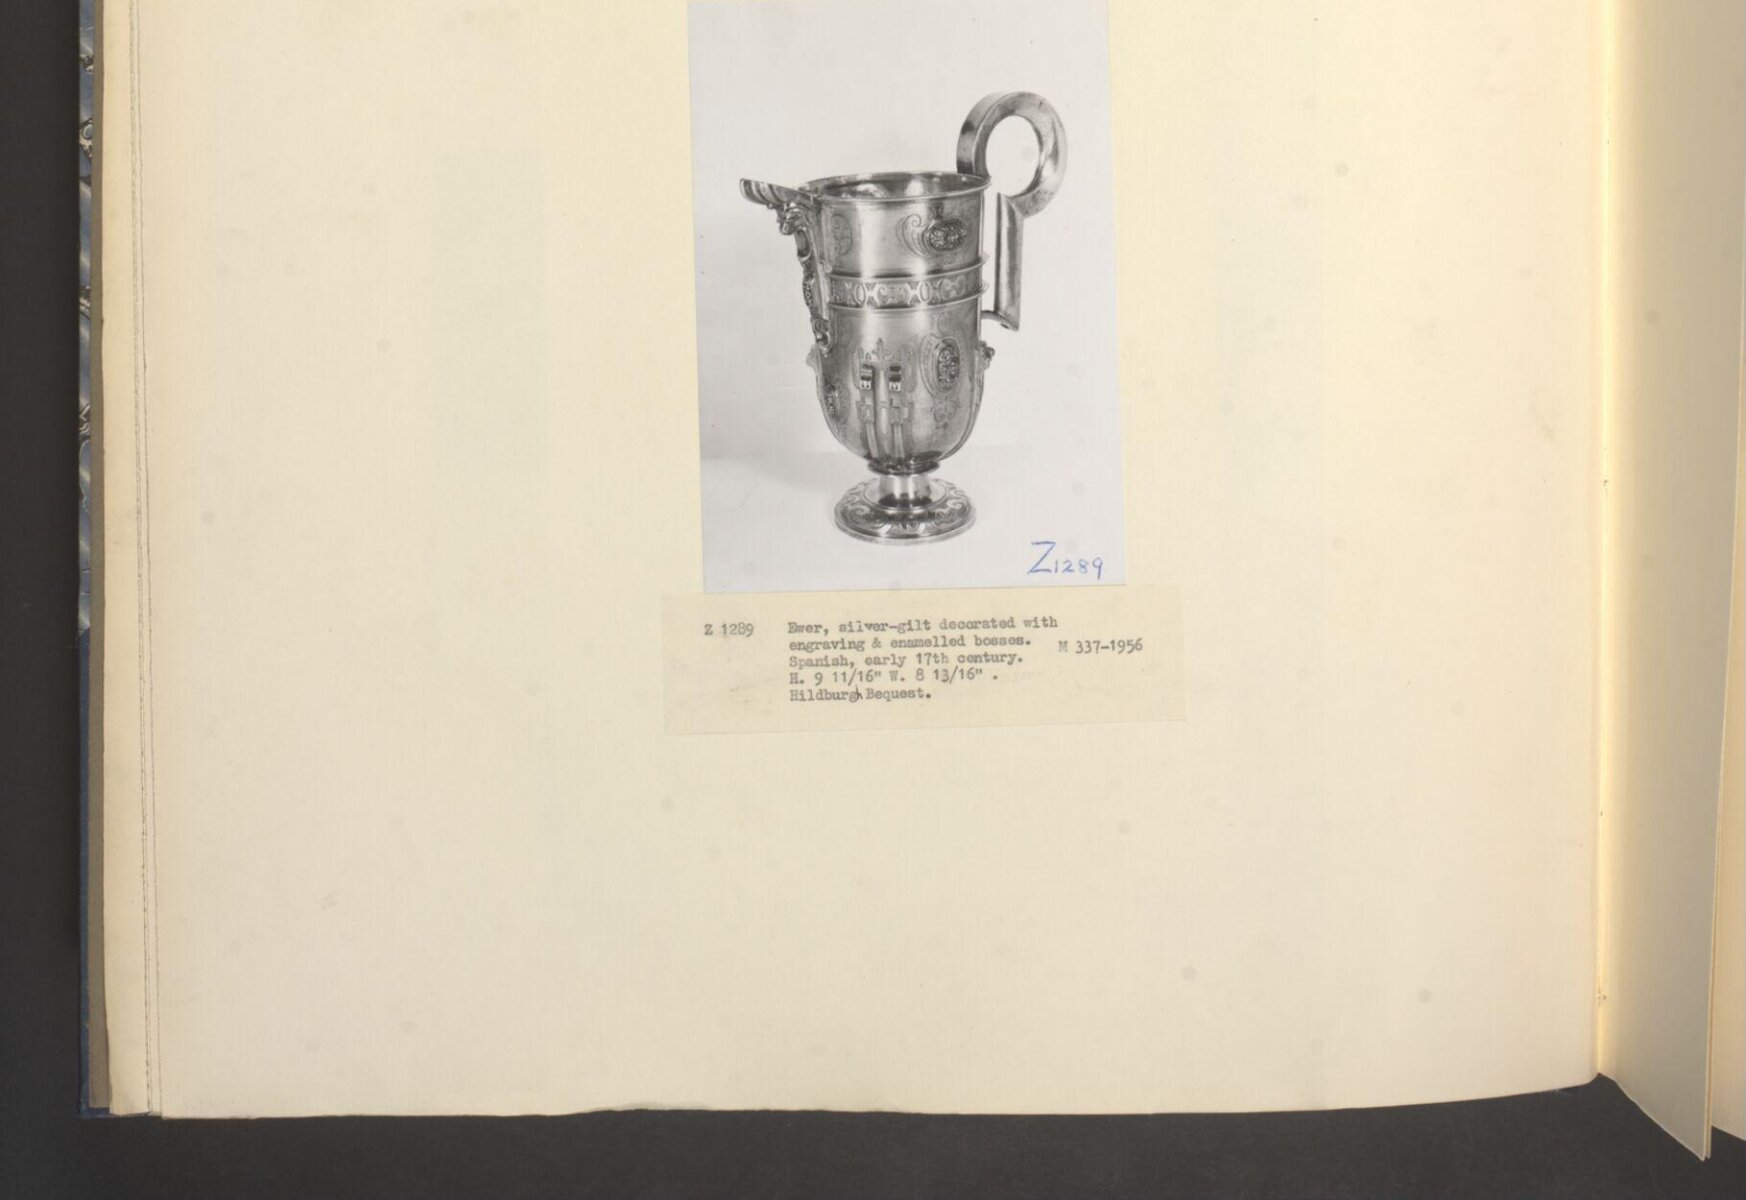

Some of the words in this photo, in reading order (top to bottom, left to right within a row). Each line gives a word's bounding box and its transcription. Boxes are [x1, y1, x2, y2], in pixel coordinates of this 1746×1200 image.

[1026, 541, 1104, 580] Z1289
[704, 624, 714, 636] Z
[721, 622, 755, 637] 1289
[787, 621, 830, 636] Ewer,
[838, 619, 931, 634] silver-gilt
[939, 617, 1016, 630] decorated
[1023, 616, 1059, 628] with
[789, 637, 866, 652] engraving
[872, 637, 882, 649] &
[890, 635, 966, 648] enamelled
[974, 634, 1032, 647] bosses.
[1058, 641, 1069, 653] M
[1075, 638, 1144, 654] 337-1956
[789, 655, 855, 670] Spanish,
[865, 653, 907, 668] early
[916, 652, 950, 666] 17th
[957, 651, 1024, 666] century.
[789, 672, 805, 685] H.
[814, 672, 824, 687] 9
[832, 668, 882, 687] 11/16"
[890, 671, 906, 682] W.
[915, 668, 925, 681] 8
[933, 665, 984, 685] 13/16"
[865, 687, 932, 702] Bequest.
